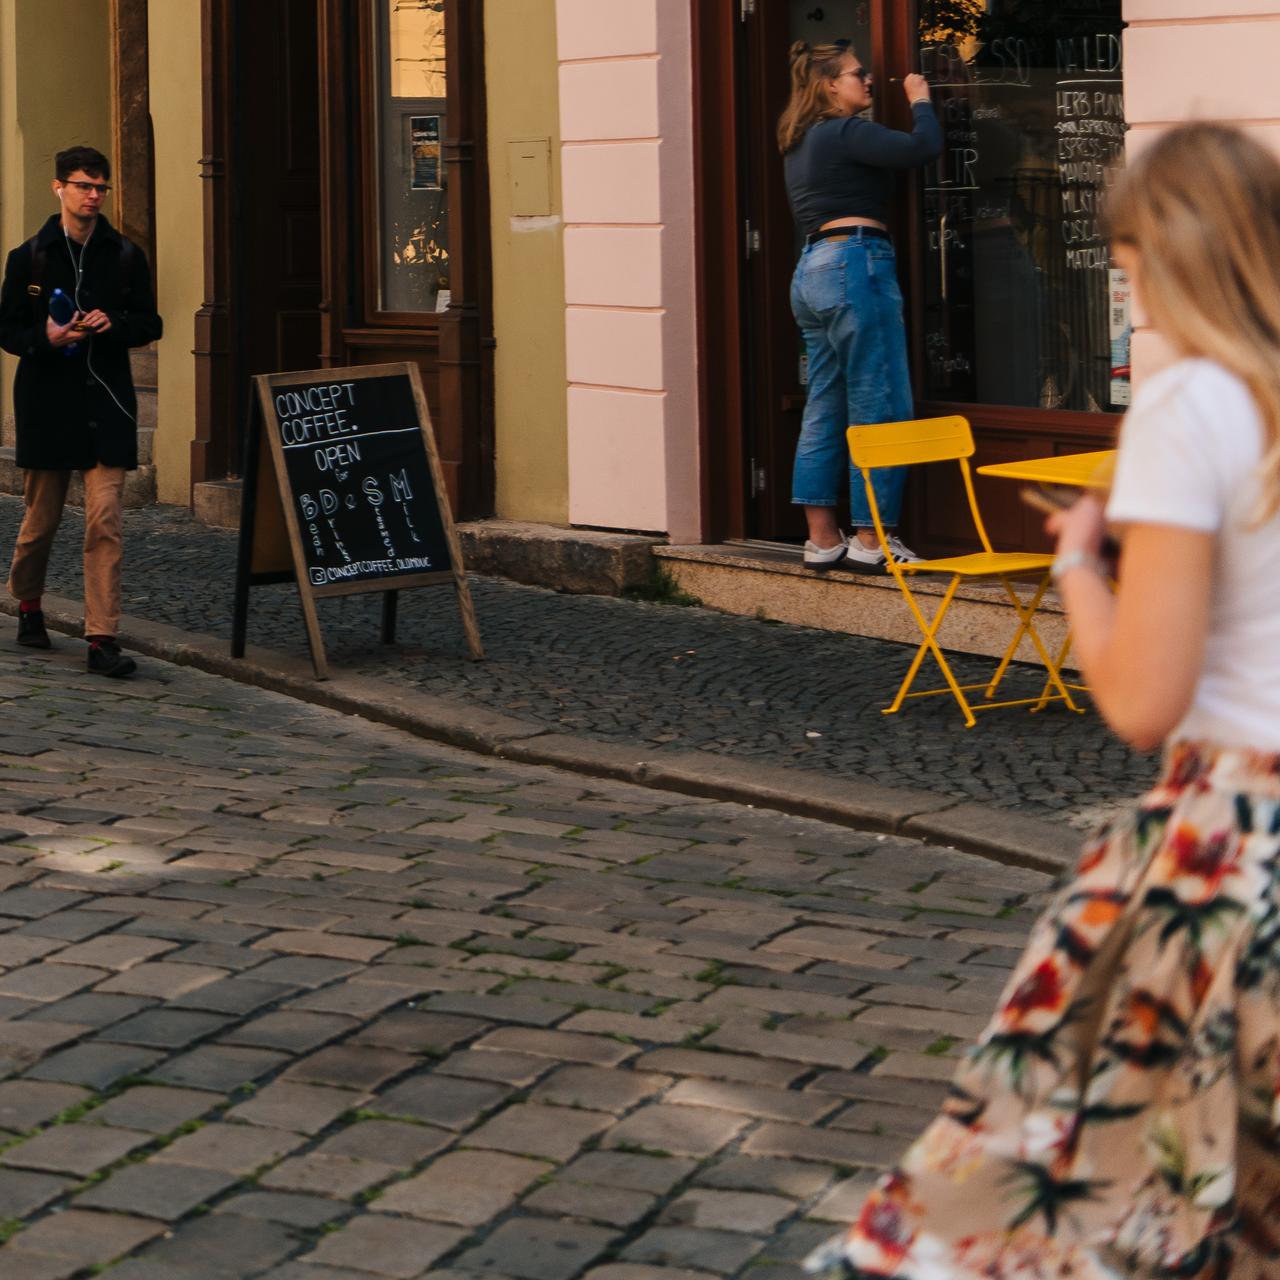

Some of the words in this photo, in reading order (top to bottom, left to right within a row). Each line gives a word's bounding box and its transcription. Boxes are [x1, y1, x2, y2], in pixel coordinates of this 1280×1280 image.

[276, 383, 355, 418] CONCEPT
[281, 410, 358, 445] COFFEE.
[314, 441, 361, 471] OPEN
